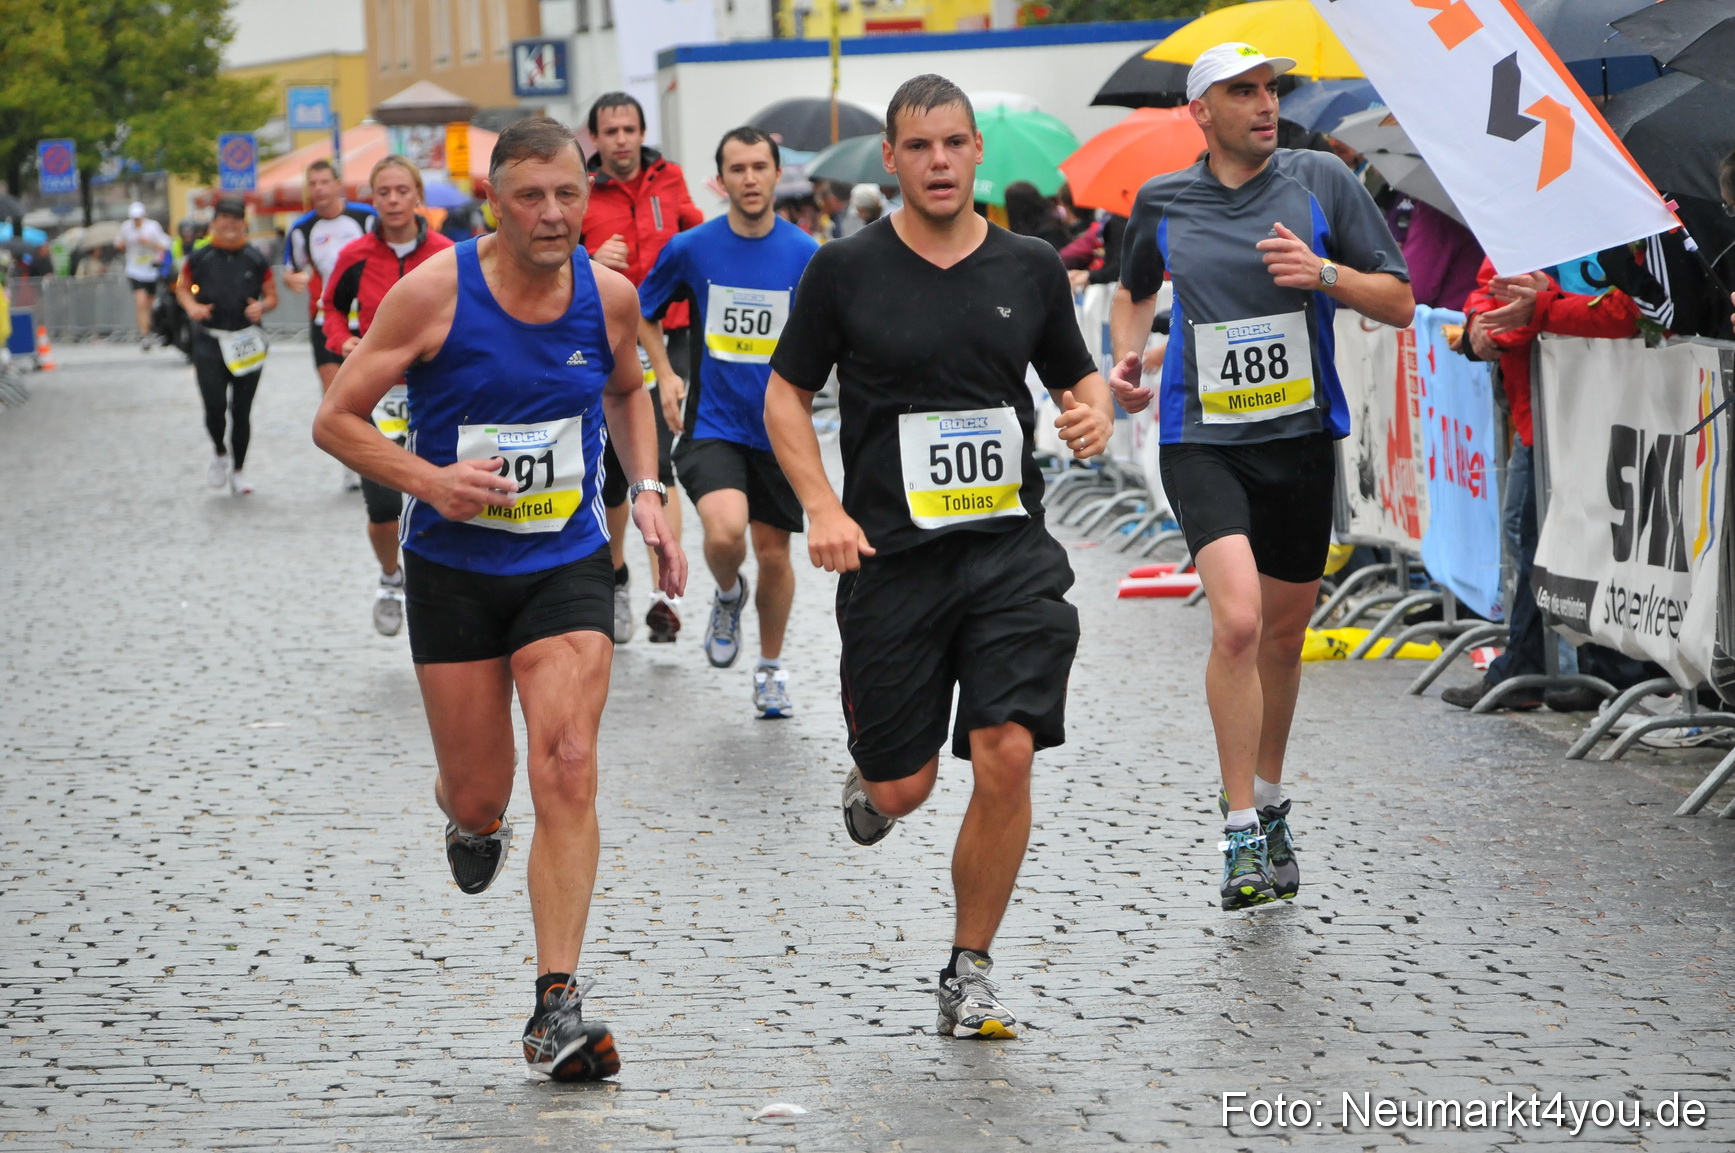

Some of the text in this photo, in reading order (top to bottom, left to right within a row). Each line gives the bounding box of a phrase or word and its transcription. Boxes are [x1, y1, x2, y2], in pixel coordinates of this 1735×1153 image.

[723, 307, 771, 335] 550
[1227, 323, 1271, 338] BOCK
[736, 341, 753, 351] Kai
[1220, 343, 1289, 386] 488
[1228, 388, 1286, 410] Michael
[940, 417, 988, 430] BOCK
[497, 430, 548, 444] BOCK
[929, 440, 1003, 485] 506
[487, 498, 552, 519] Manfred
[942, 493, 994, 511] Tobias
